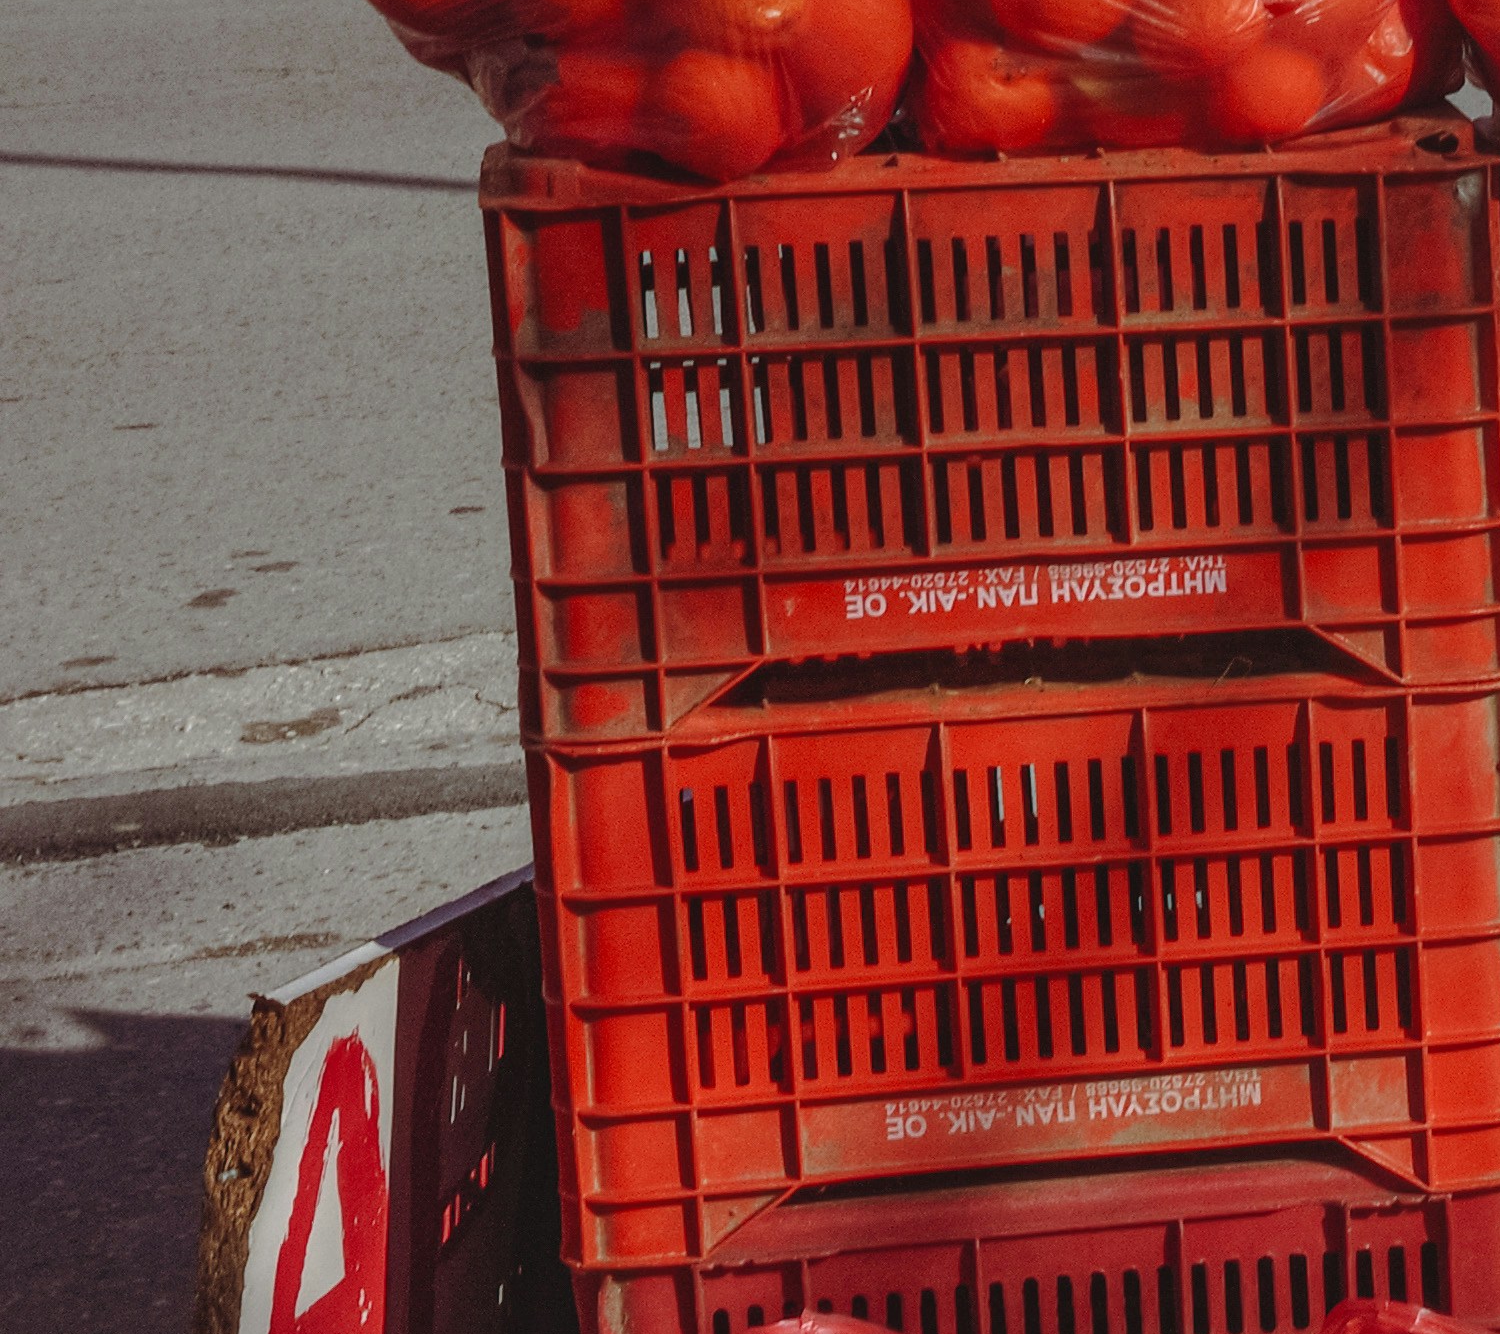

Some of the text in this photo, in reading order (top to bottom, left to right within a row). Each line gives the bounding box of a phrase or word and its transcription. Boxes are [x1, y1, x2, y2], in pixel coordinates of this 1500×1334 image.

[1051, 569, 1227, 604] ΜΗΤΡΟΣΥΛΗ
[845, 593, 887, 620] ΟΕ
[1088, 1082, 1261, 1121] ΜΗΤΡΟΣΥΛΗ
[886, 1114, 927, 1141] ΟΕ
